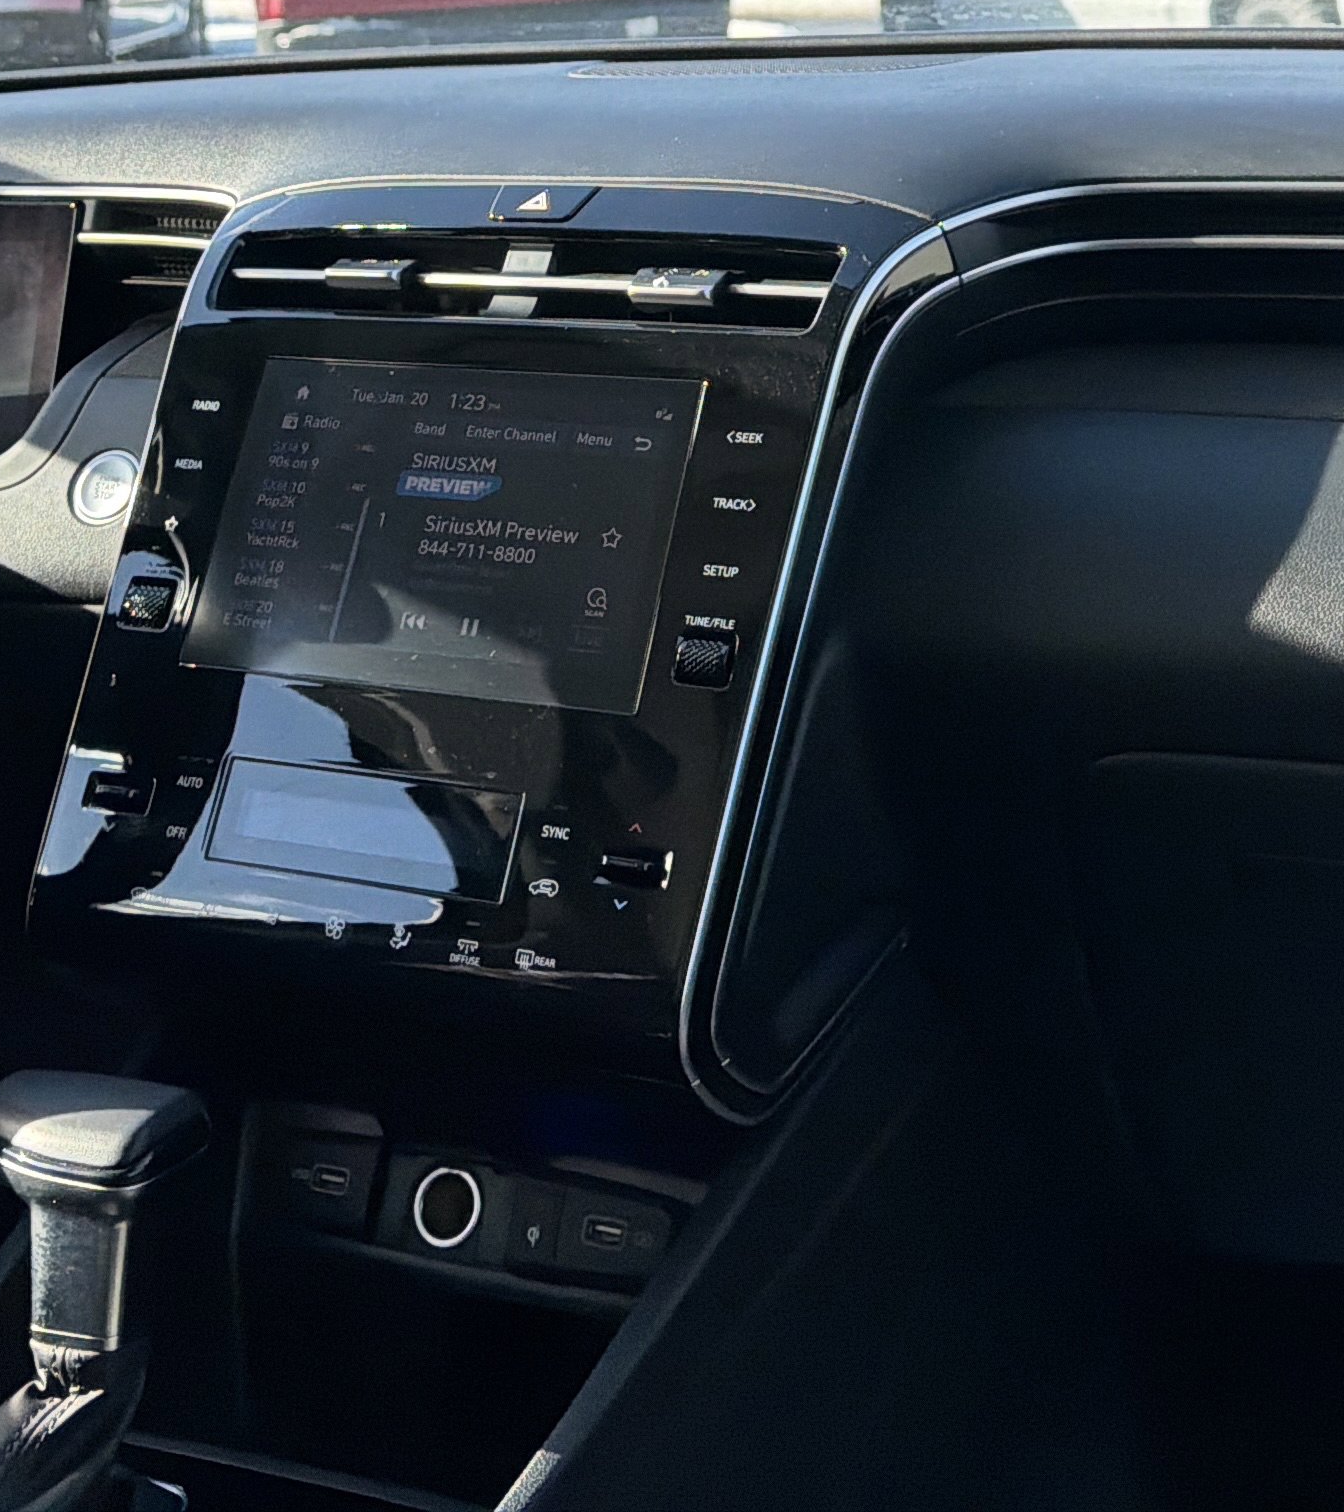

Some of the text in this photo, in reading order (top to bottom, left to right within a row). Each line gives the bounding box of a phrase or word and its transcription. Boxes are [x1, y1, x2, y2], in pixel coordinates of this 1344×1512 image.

[192, 400, 220, 412] RADIO
[410, 393, 428, 406] 20
[449, 393, 487, 411] 1:23
[303, 415, 341, 430] Radio
[415, 422, 613, 447] Band Enter Channel Menu
[735, 432, 763, 444] SEEK
[301, 441, 309, 454] 9
[174, 458, 202, 470] MEDIA
[267, 455, 320, 471] 90s on 9
[411, 452, 497, 474] SIRIUSXM
[291, 480, 306, 494] 10
[404, 476, 492, 496] PREVIEW
[256, 494, 297, 508] Pop2K
[713, 497, 747, 510] TRACK
[280, 520, 295, 534] 15
[424, 514, 500, 538] SiriusXM
[505, 521, 579, 545] Preview
[247, 532, 301, 550] YachtRck
[418, 539, 536, 565] 844-711-8800
[269, 560, 285, 574] 18
[702, 564, 739, 578] SETUP
[234, 572, 280, 590] Beatles
[255, 601, 273, 614] 20
[584, 610, 605, 618] SCAN
[223, 613, 272, 630] E Street
[684, 614, 736, 630] TUNE/FILE
[176, 775, 203, 789] AUTO
[540, 824, 571, 841] SYNC
[449, 953, 481, 967] DIFFUSE
[534, 956, 556, 968] REAR
